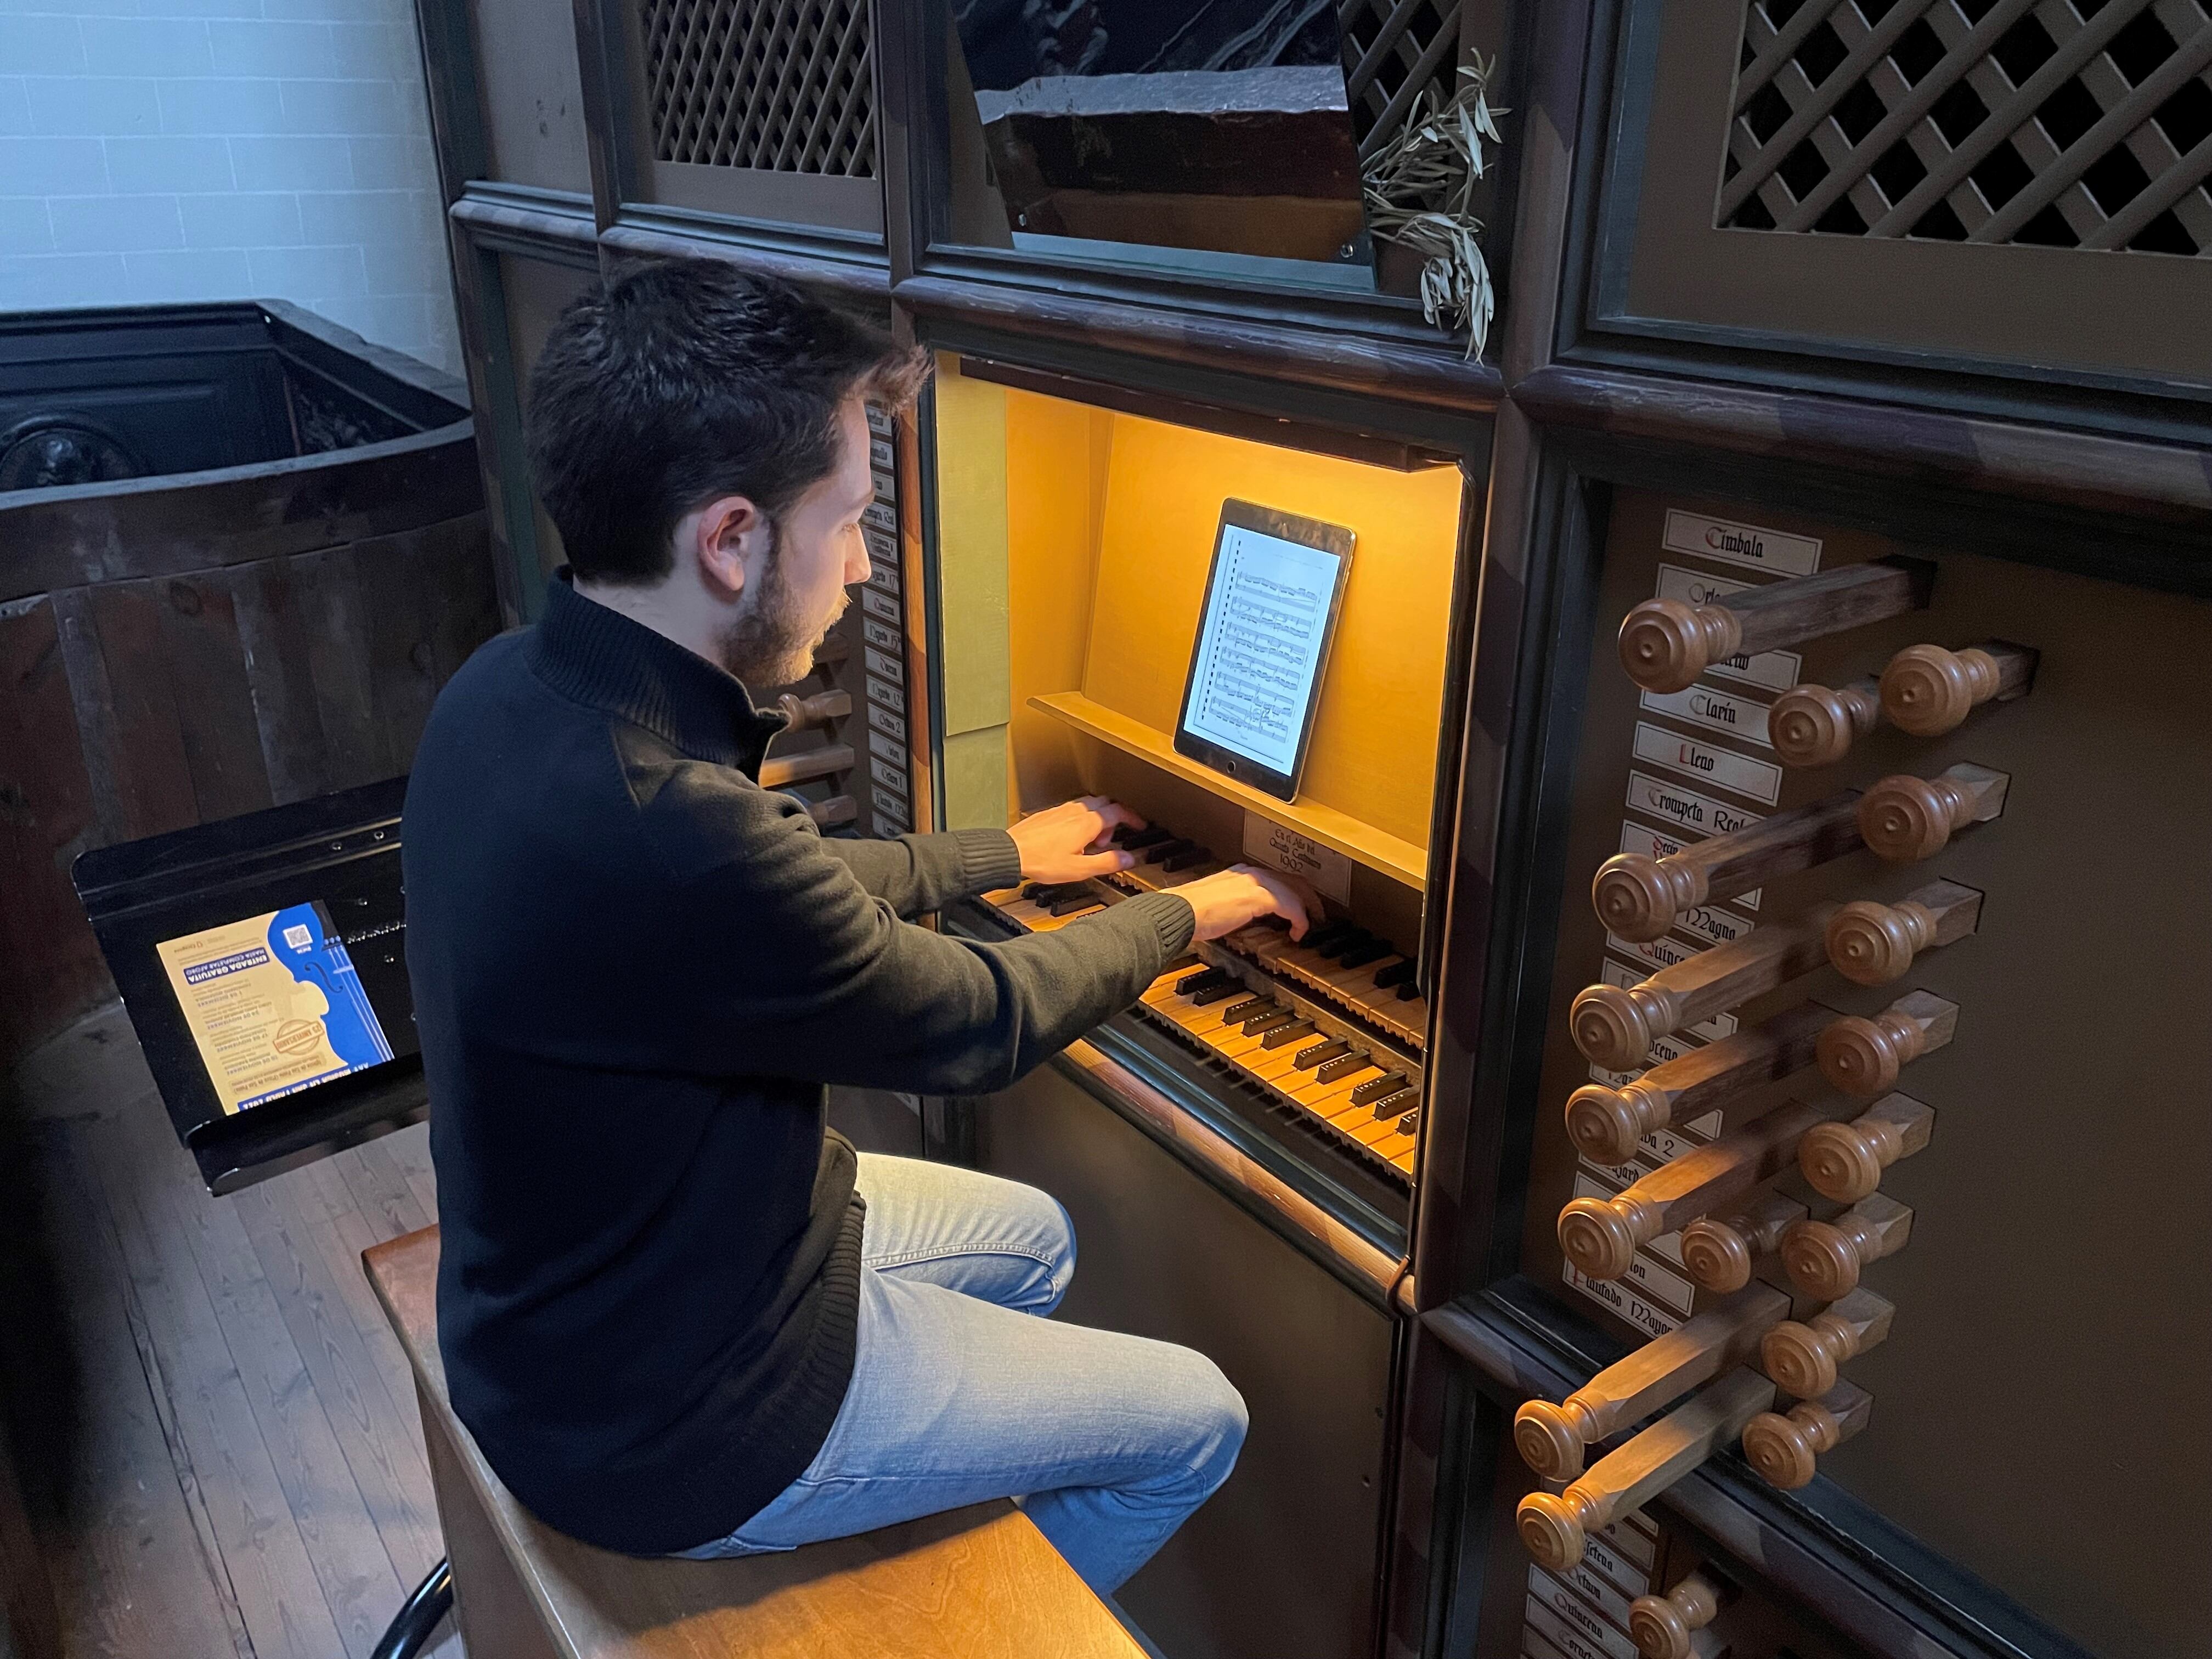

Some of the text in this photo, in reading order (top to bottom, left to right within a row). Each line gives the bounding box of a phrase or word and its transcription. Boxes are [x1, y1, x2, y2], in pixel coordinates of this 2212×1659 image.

[1679, 744, 1714, 771] Lleno
[1649, 788, 1703, 821] Trompeta
[1280, 853, 1304, 873] 1992
[187, 954, 268, 983] ENTRADA GRATUITA
[1663, 1139, 1674, 1158] 2
